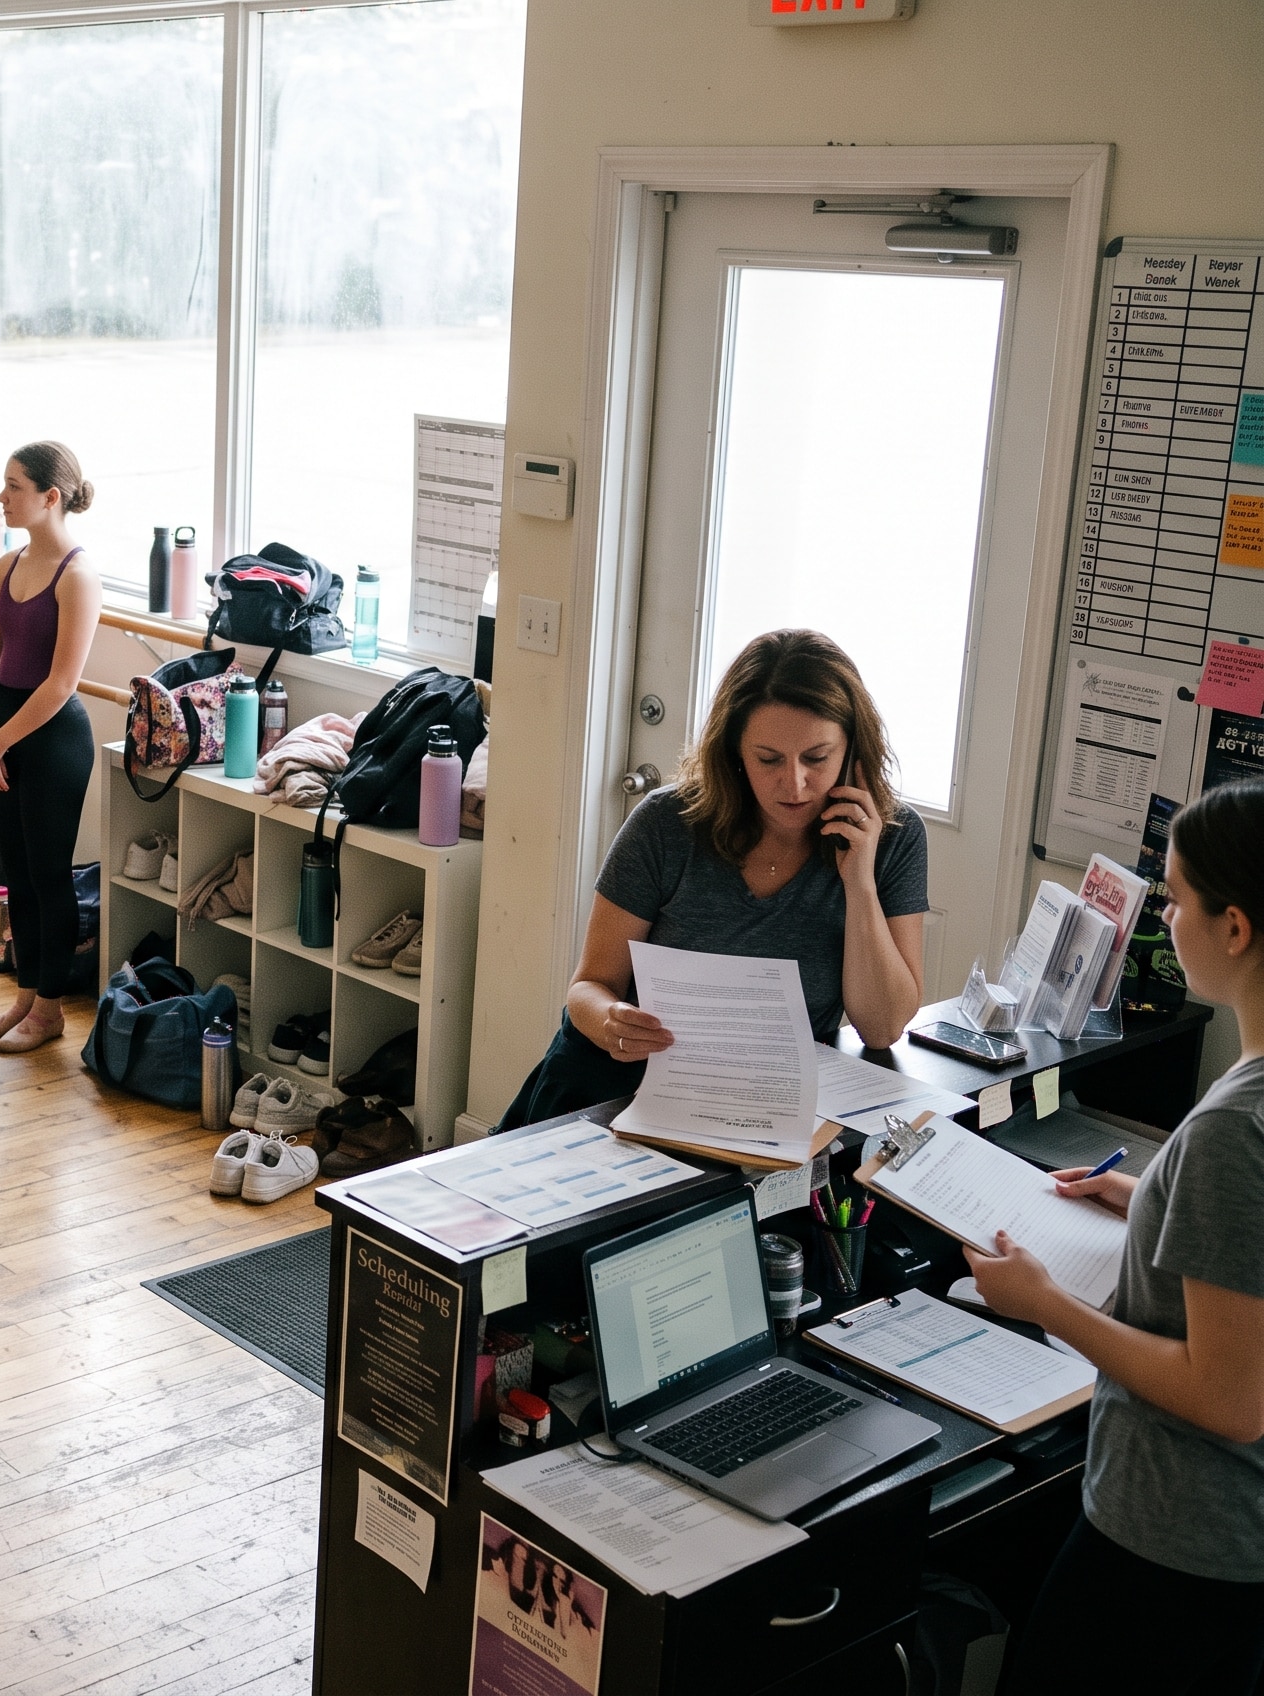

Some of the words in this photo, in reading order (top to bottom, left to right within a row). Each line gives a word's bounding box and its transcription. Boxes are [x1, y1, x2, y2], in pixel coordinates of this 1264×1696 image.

[1117, 292, 1123, 302] 1
[1114, 310, 1121, 320] 2
[1112, 327, 1119, 337] 3
[1110, 345, 1116, 355] 4
[1108, 363, 1114, 373] 5
[1105, 381, 1112, 391] 6
[1103, 399, 1110, 409] 7
[1100, 418, 1107, 428] 8
[1098, 435, 1105, 445] 9
[1090, 489, 1101, 499] 12
[1088, 507, 1099, 517] 13
[1085, 525, 1097, 535] 14
[1079, 577, 1090, 587] 16
[1077, 595, 1088, 605] 17
[1072, 629, 1084, 640] 30
[357, 1248, 451, 1318] Scheduling
